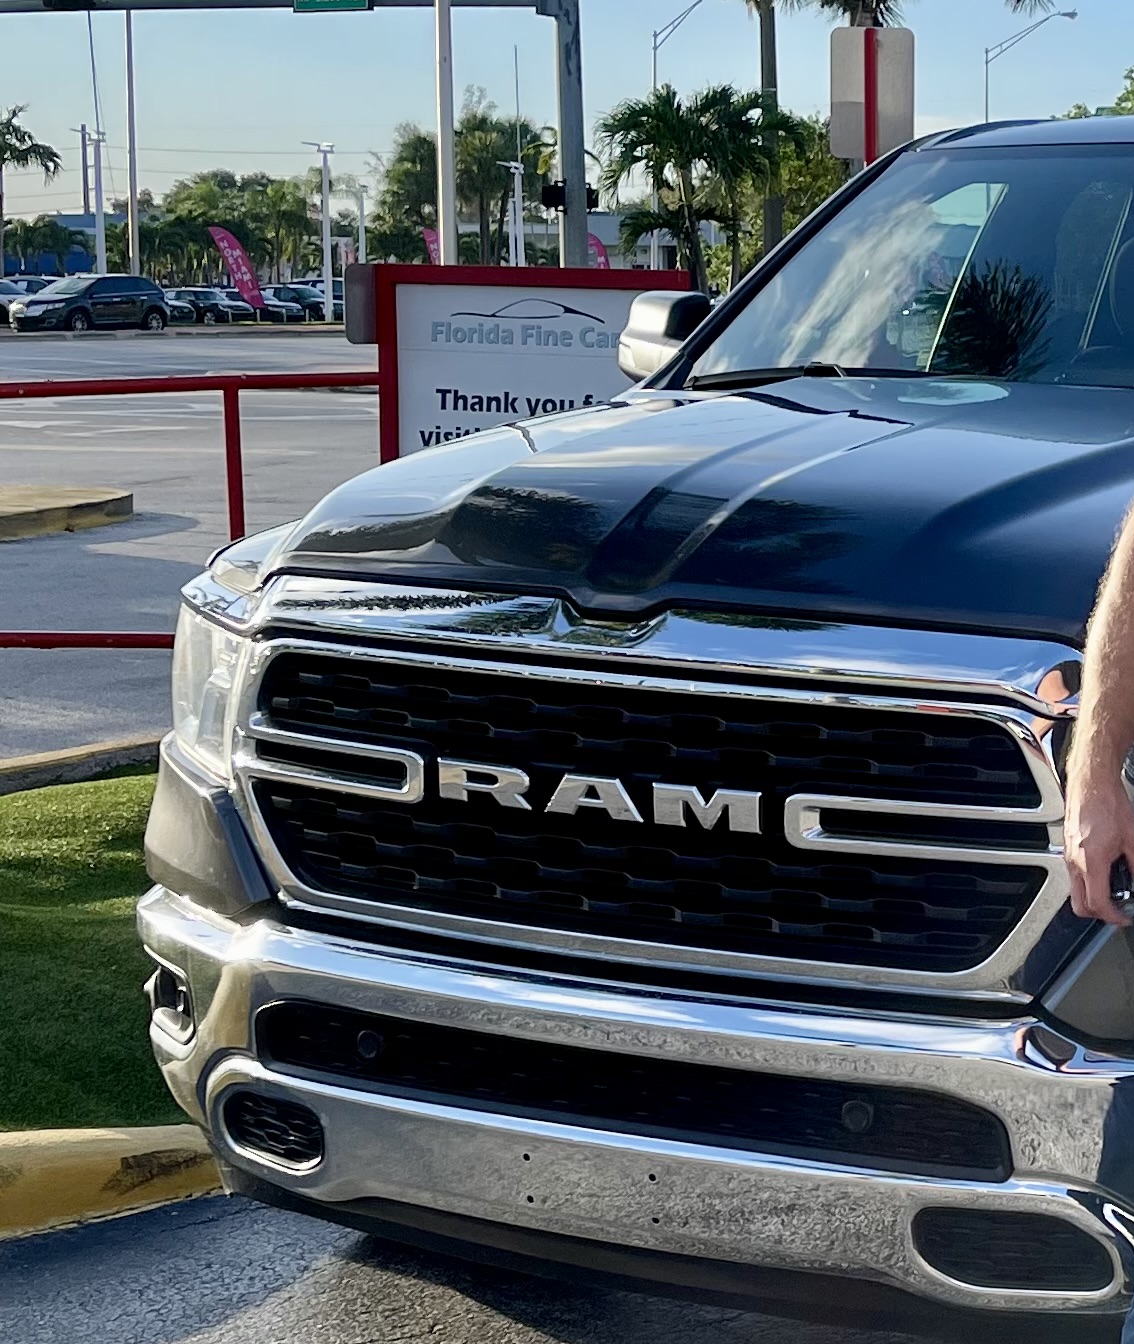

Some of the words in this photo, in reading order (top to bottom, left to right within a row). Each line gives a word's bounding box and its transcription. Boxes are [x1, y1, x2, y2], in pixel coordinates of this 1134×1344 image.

[219, 239, 242, 281] NORTH
[232, 248, 253, 289] MIAMI
[431, 321, 514, 345] Florida
[521, 324, 573, 347] Fine
[436, 388, 518, 413] Thank
[525, 397, 574, 416] you
[437, 755, 761, 834] RAM
